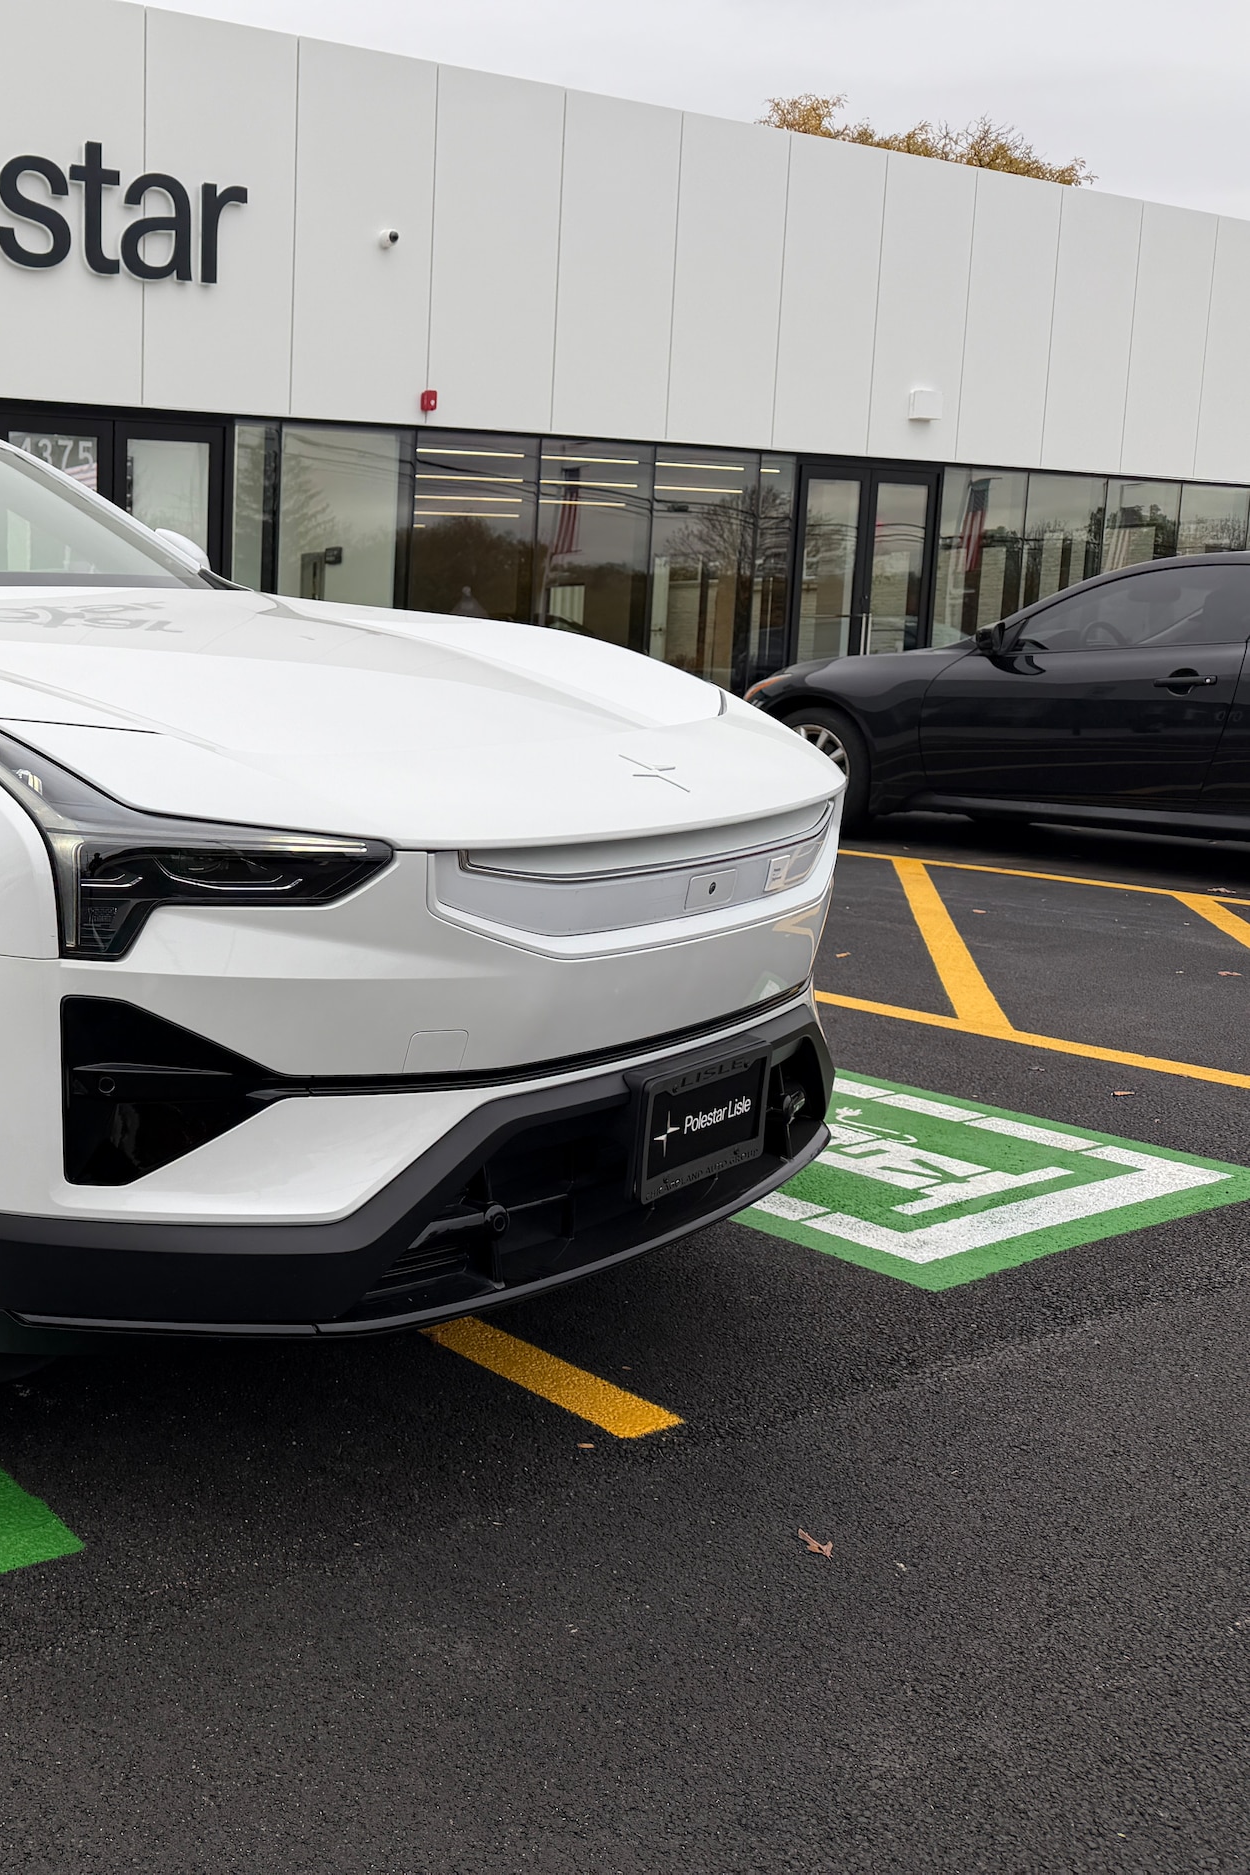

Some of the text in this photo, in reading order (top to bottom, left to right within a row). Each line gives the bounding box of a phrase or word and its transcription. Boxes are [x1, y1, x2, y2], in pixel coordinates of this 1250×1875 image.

[680, 1058, 745, 1088] LISLE
[683, 1095, 752, 1135] Polestar Lisle
